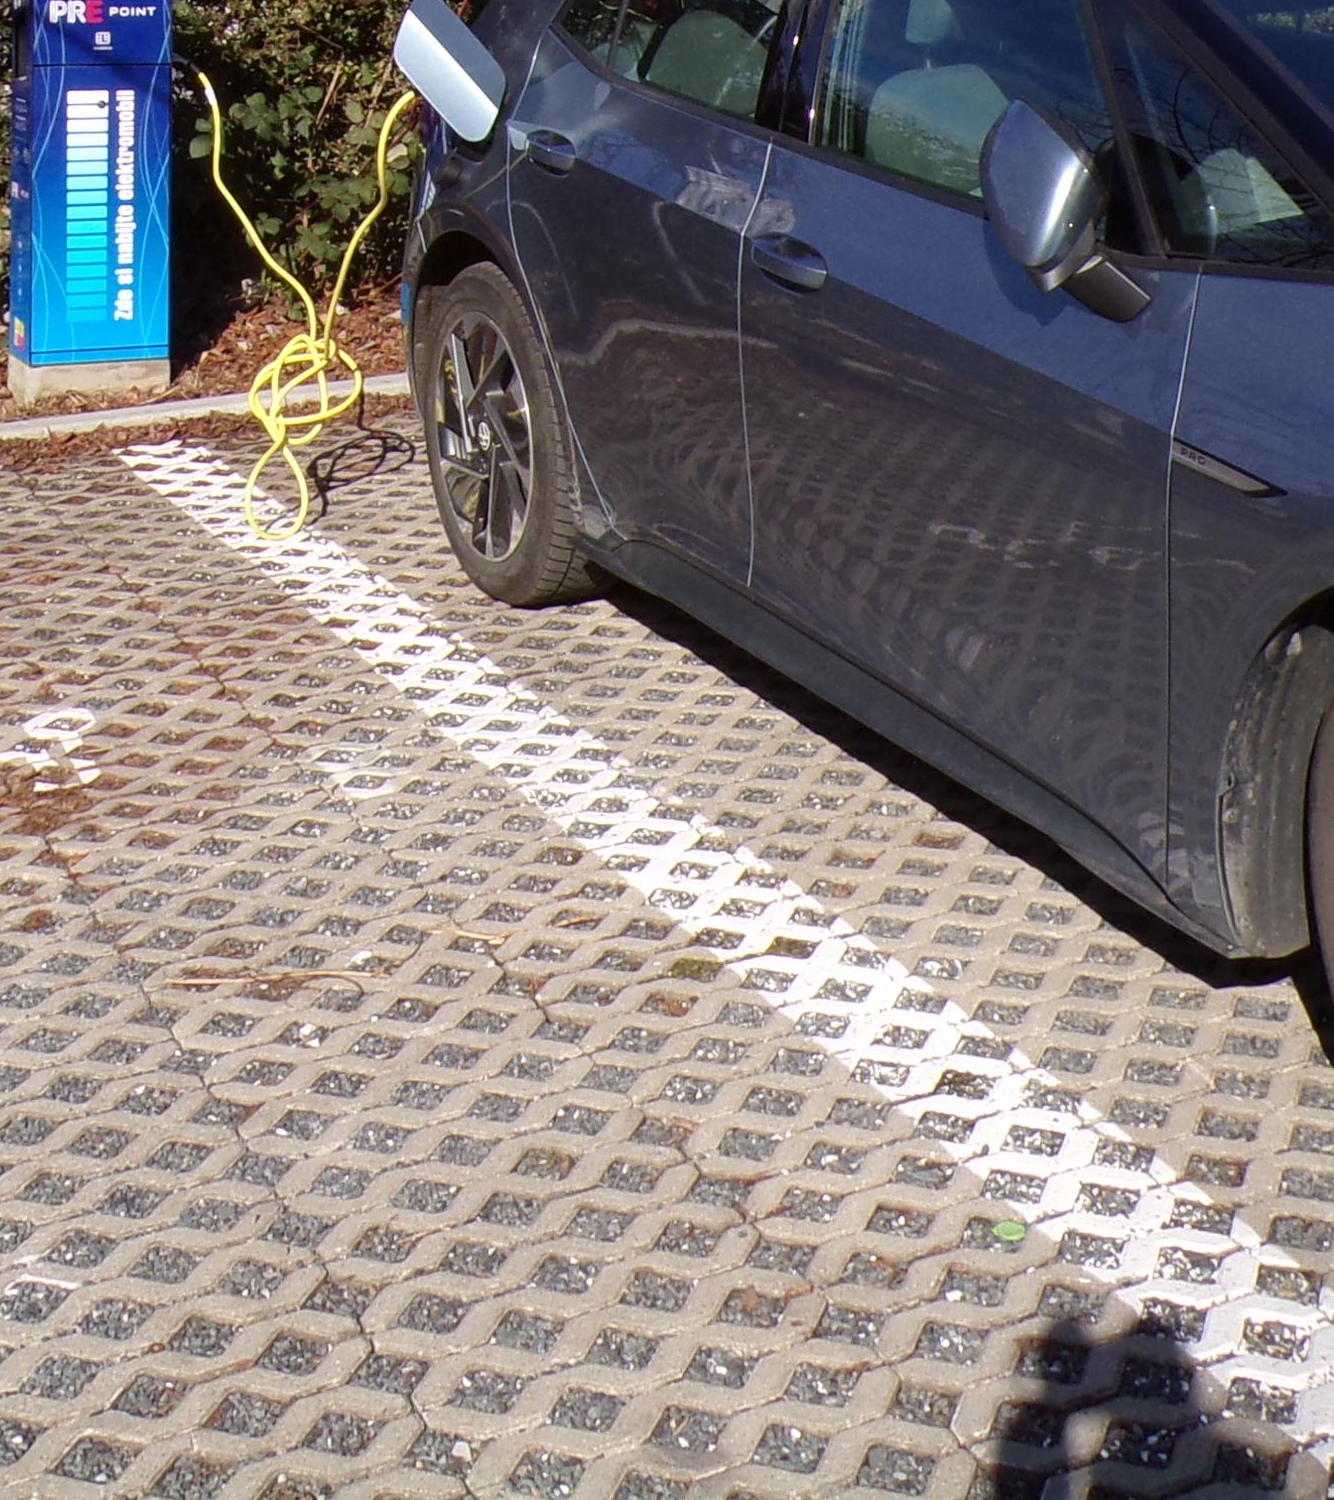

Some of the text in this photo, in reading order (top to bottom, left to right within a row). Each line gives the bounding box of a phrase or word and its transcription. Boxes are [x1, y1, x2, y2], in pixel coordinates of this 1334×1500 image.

[49, 0, 157, 24] PRE POINT
[114, 89, 135, 200] elektromobil
